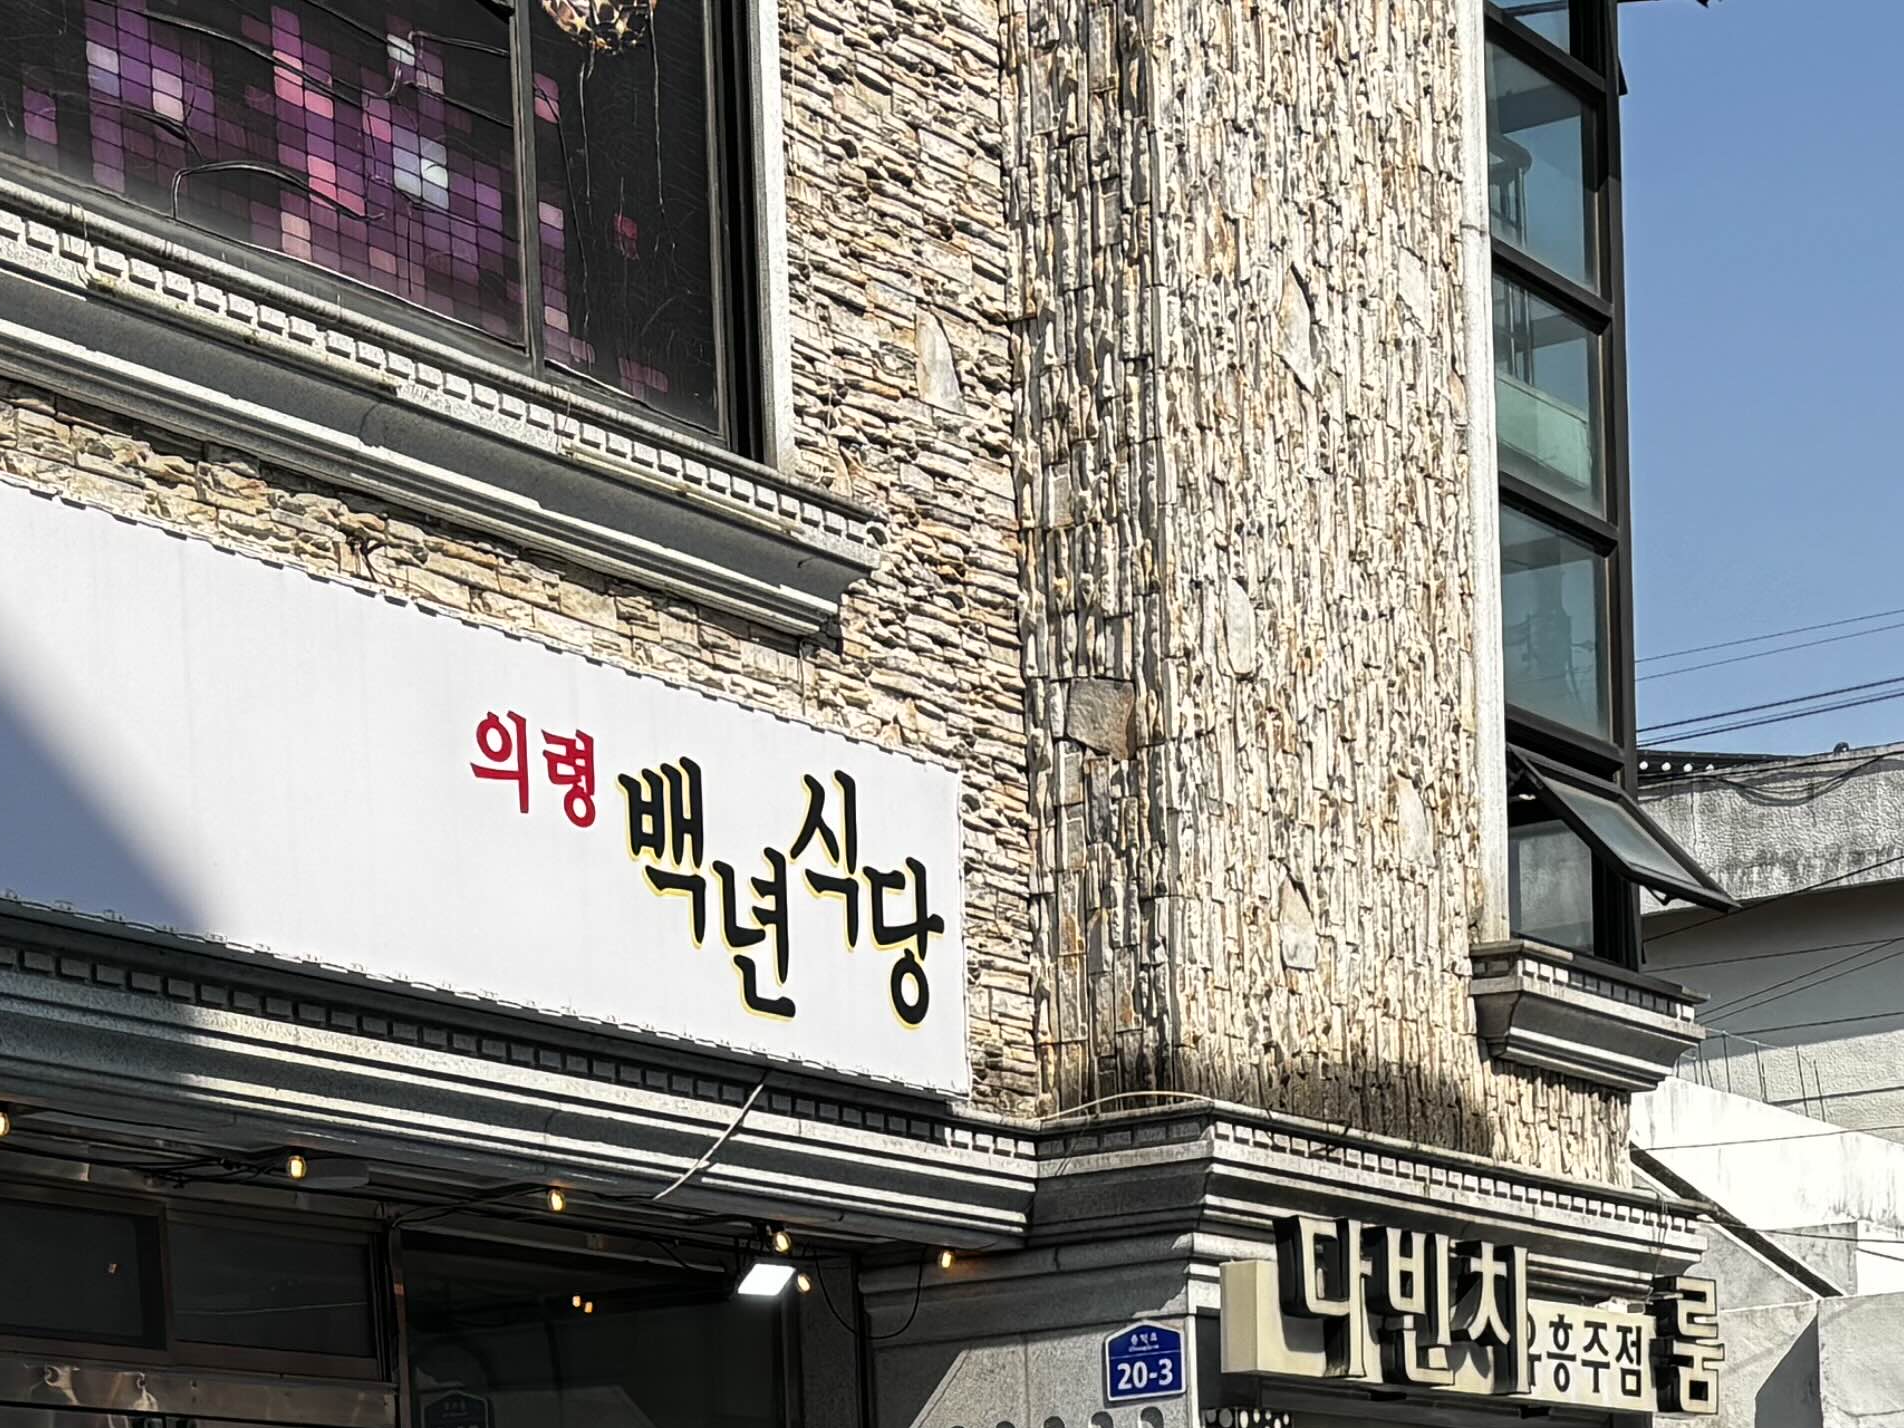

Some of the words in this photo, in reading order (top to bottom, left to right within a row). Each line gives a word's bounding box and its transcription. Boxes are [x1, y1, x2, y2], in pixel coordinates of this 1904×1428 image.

[470, 710, 596, 828] 의령
[618, 756, 945, 1027] 백년식당
[1117, 1358, 1173, 1390] 20-3
[1296, 1214, 1531, 1395] 다빈치
[1675, 1275, 1725, 1415] 룸
